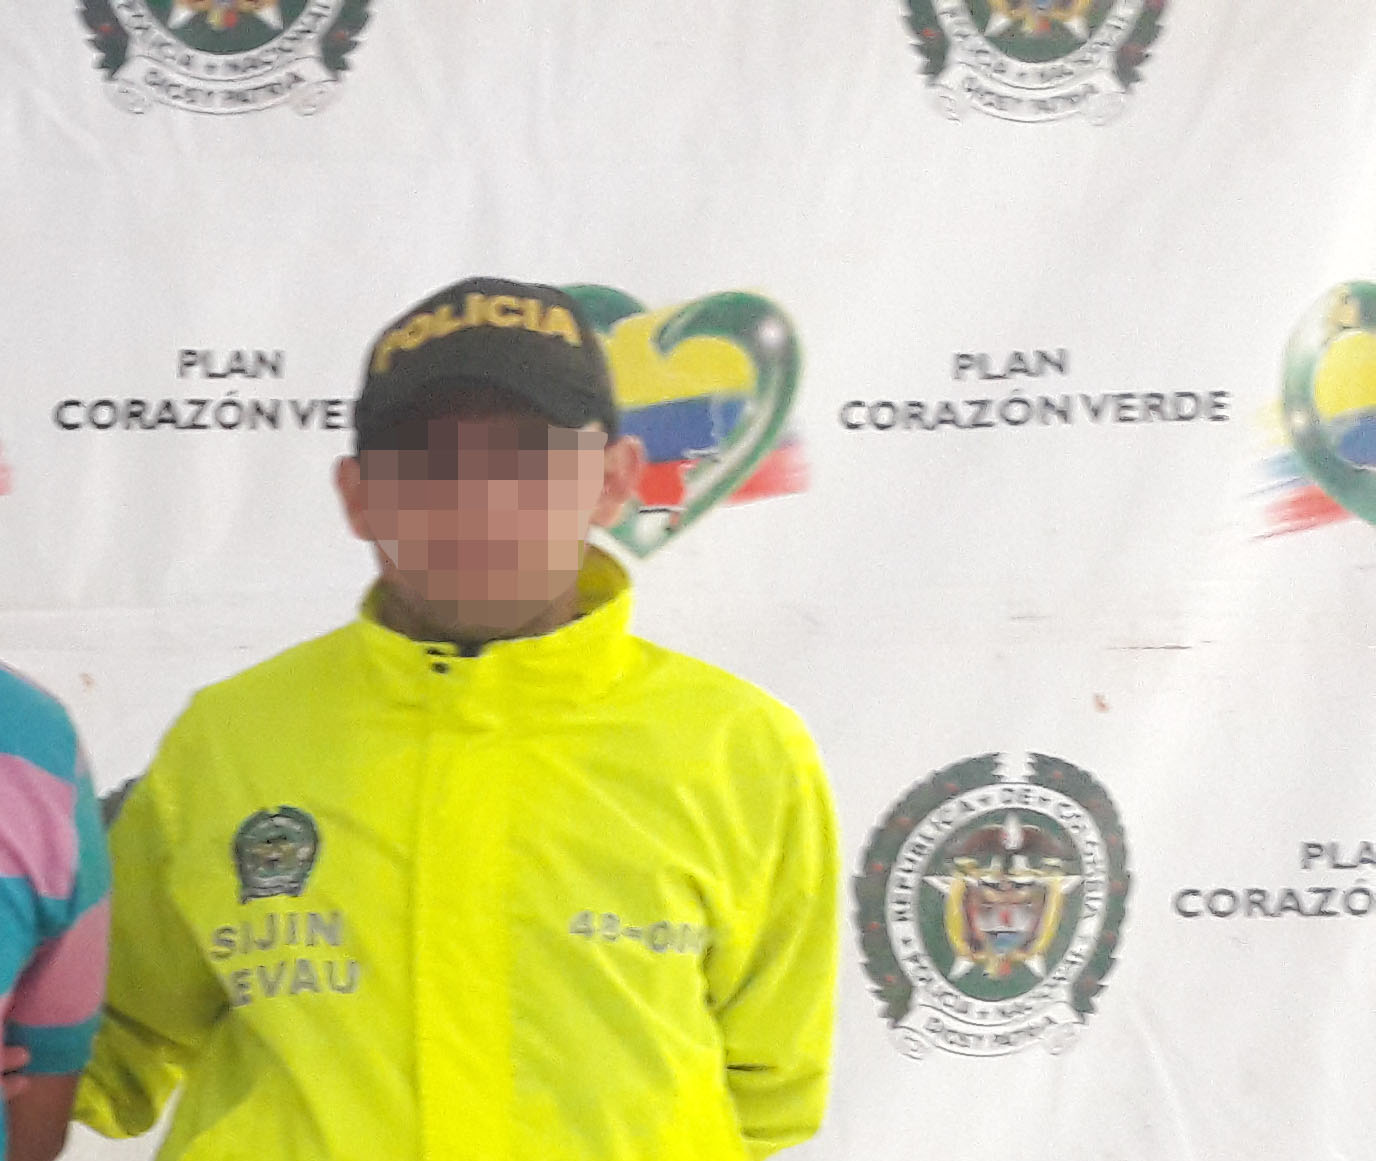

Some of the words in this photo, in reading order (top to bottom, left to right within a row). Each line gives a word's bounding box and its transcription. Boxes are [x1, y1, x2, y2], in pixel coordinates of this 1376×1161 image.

[371, 292, 583, 374] POLICIA
[176, 349, 286, 379] PLAN
[953, 348, 1068, 380] PLAN
[52, 389, 281, 430] CORAZÓN
[838, 388, 1073, 431] CORAZÓN
[1079, 390, 1234, 424] VERDE
[1301, 841, 1376, 870] PLA
[1172, 878, 1375, 918] CORAZÓ
[209, 911, 344, 963] SIJIN
[229, 959, 361, 1007] EVAU
